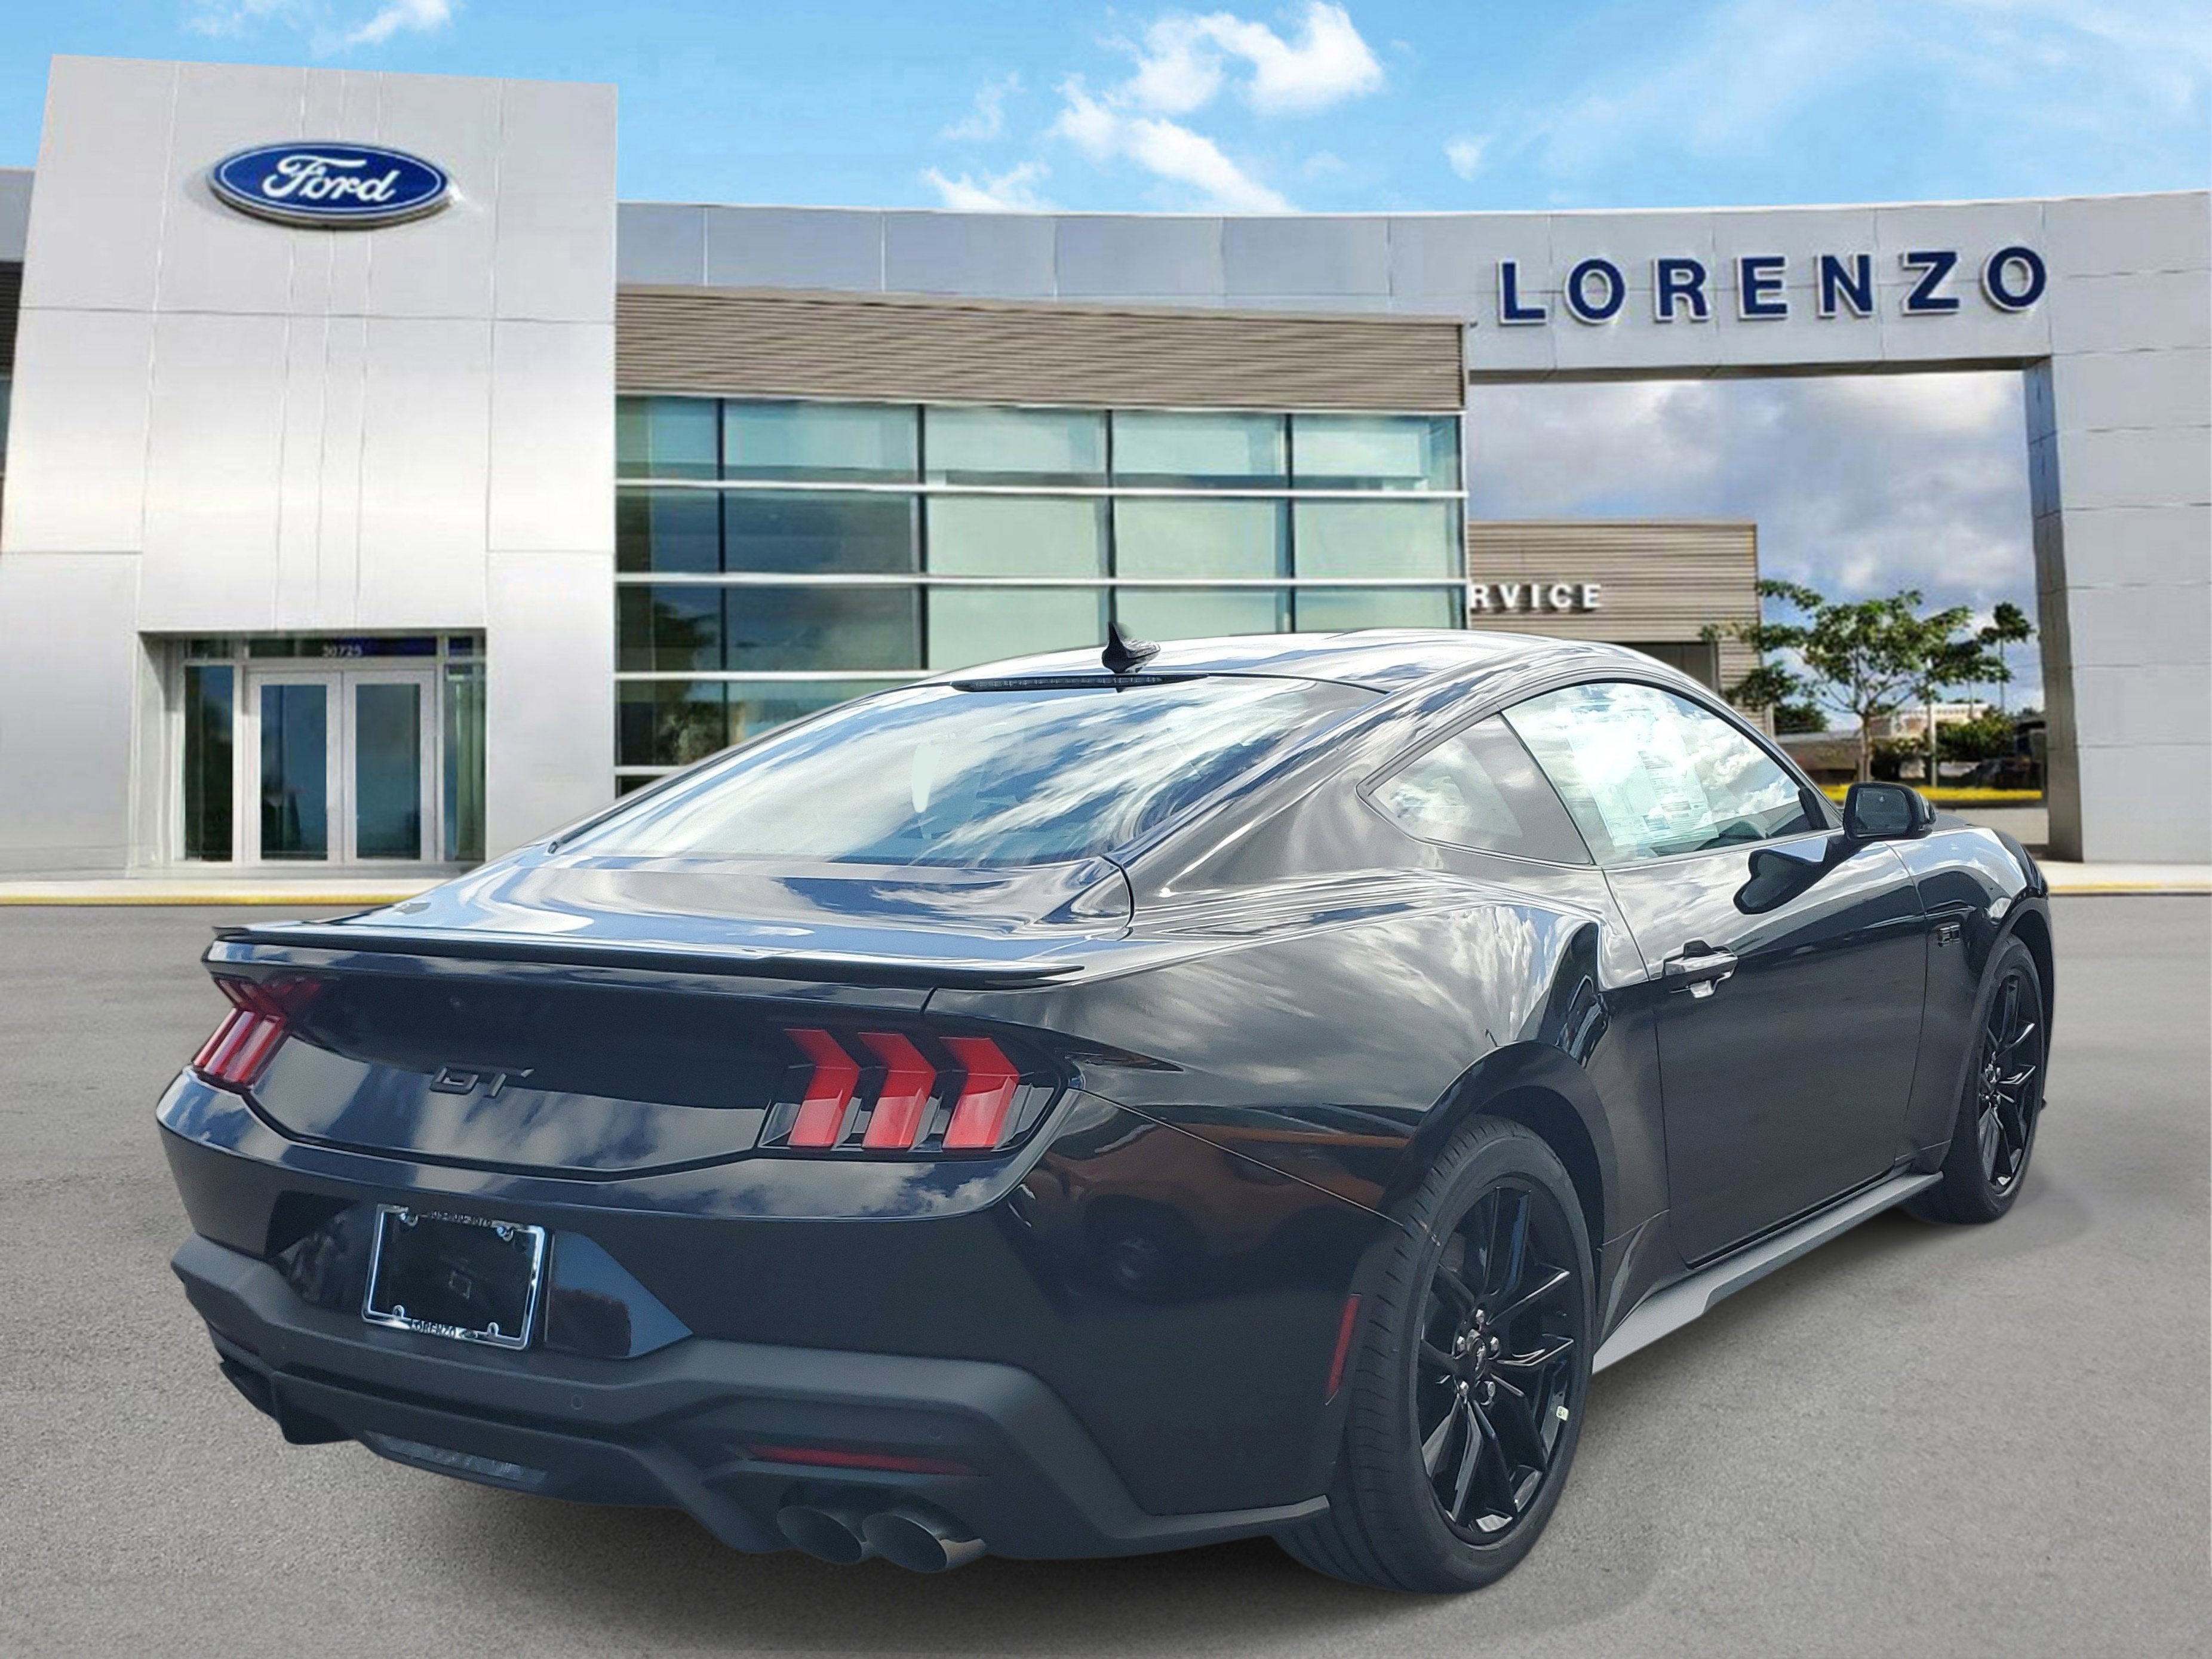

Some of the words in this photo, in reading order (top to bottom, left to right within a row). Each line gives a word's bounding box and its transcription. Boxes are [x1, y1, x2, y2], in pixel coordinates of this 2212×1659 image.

[262, 155, 401, 202] Ford
[1498, 245, 2047, 325] LORENZO
[1469, 583, 1602, 609] RVICE
[429, 1062, 535, 1099] GT
